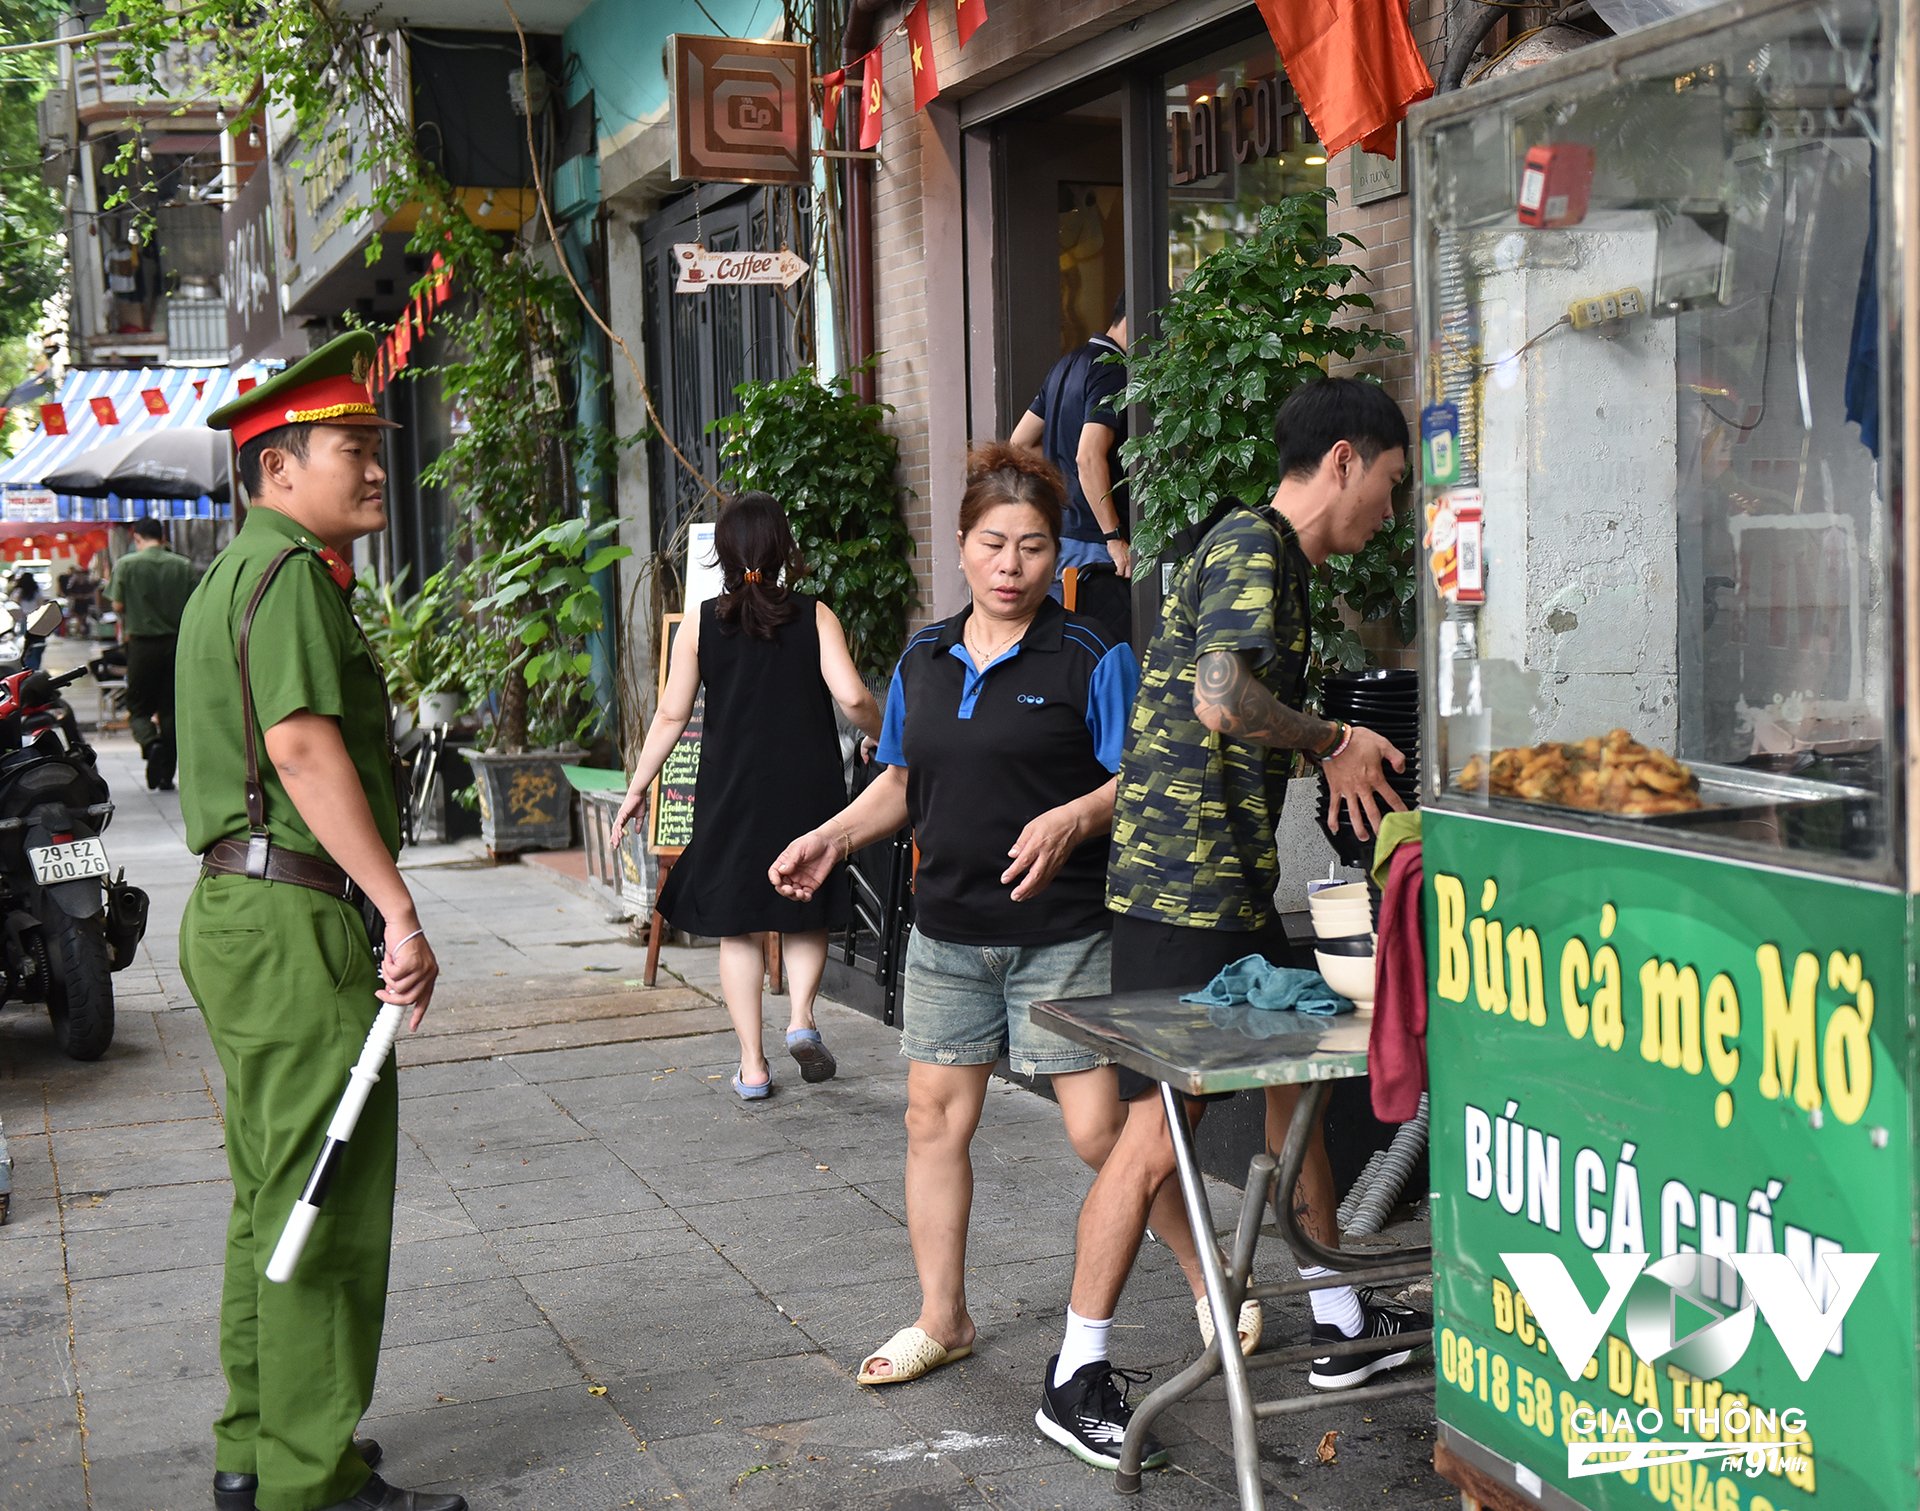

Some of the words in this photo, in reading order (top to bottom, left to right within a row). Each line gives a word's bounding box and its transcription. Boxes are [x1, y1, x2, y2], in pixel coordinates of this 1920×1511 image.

[1172, 97, 1222, 185] LAI
[717, 255, 772, 281] Coffee
[39, 858, 105, 882] 700.26
[40, 842, 94, 864] 29-E2
[1434, 873, 1547, 1027] Bún
[1560, 903, 1625, 1052] cá
[1639, 958, 1741, 1129] mẹ
[1756, 943, 1874, 1125] Mỡ
[1465, 1098, 1561, 1235] BÚN
[1574, 1140, 1647, 1260] CÁ
[1441, 1328, 1511, 1413] 0818
[1516, 1365, 1555, 1438] 58
